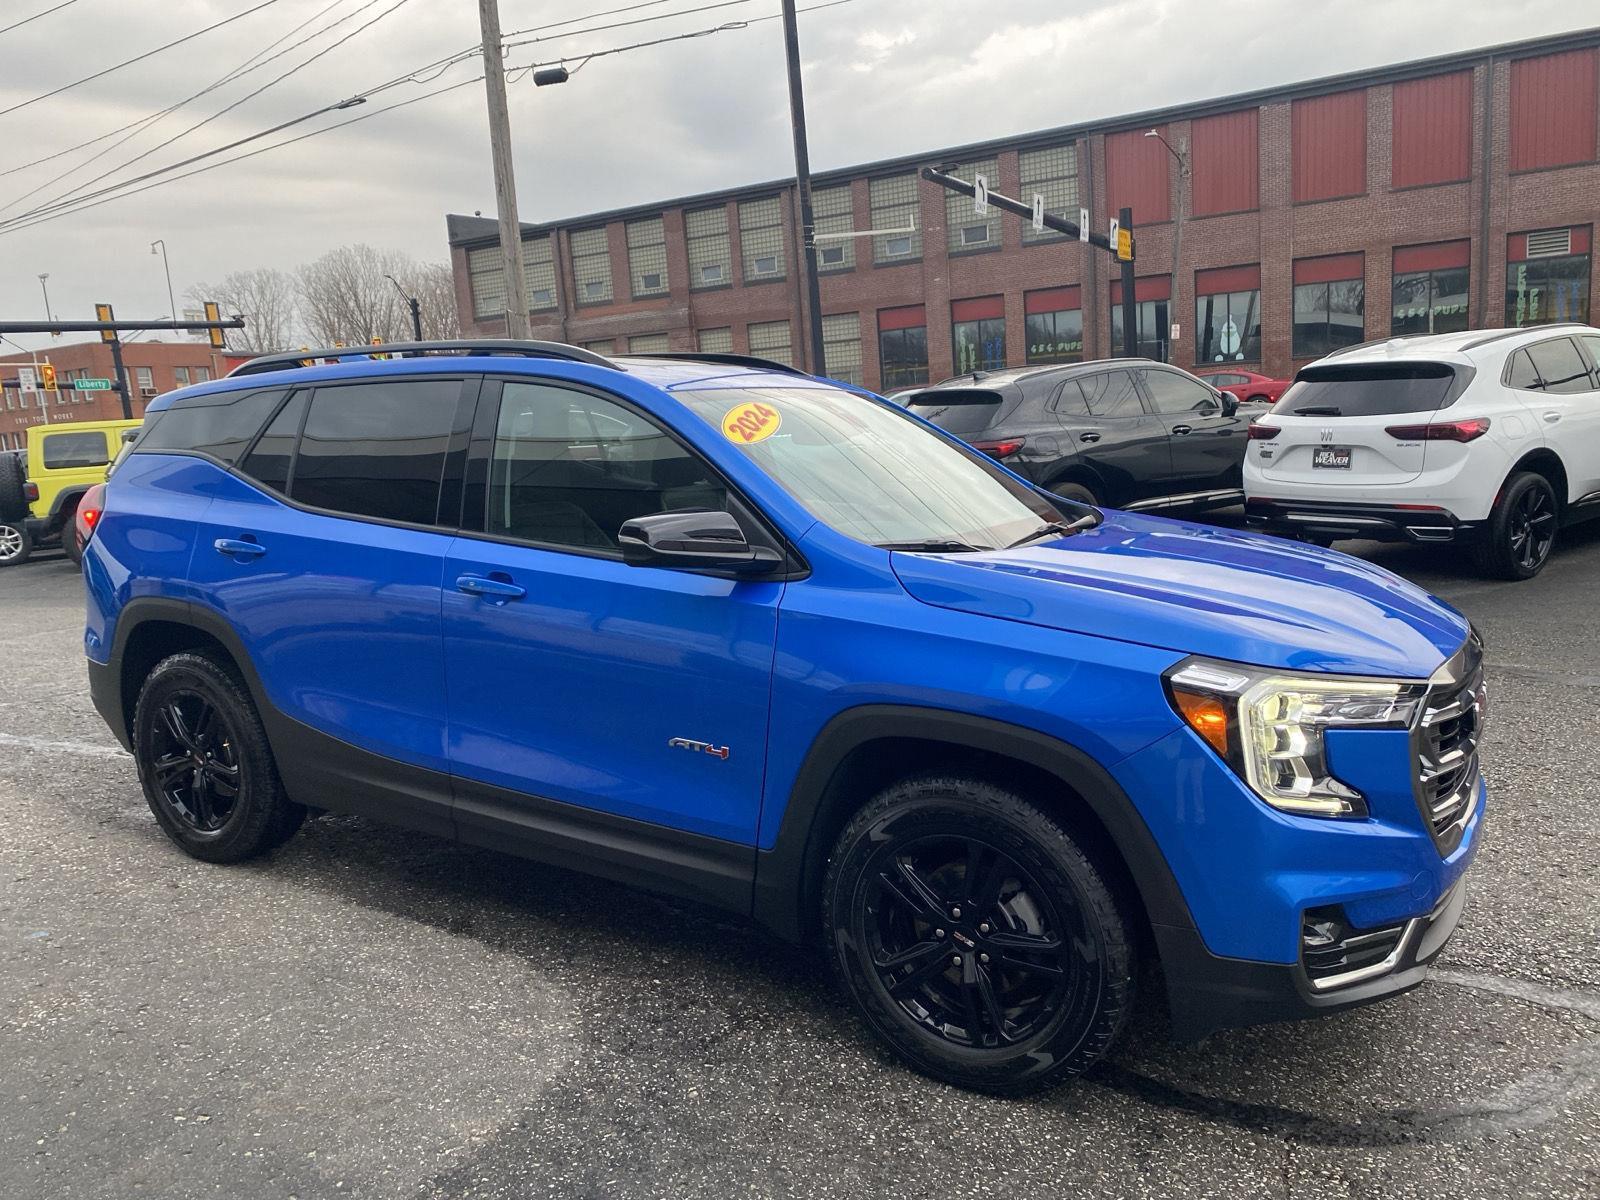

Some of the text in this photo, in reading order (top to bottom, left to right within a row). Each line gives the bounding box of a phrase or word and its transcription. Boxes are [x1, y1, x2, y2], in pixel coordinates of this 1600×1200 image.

[79, 381, 106, 389] Liberty
[728, 403, 777, 441] 2024
[669, 737, 729, 760] AT4
